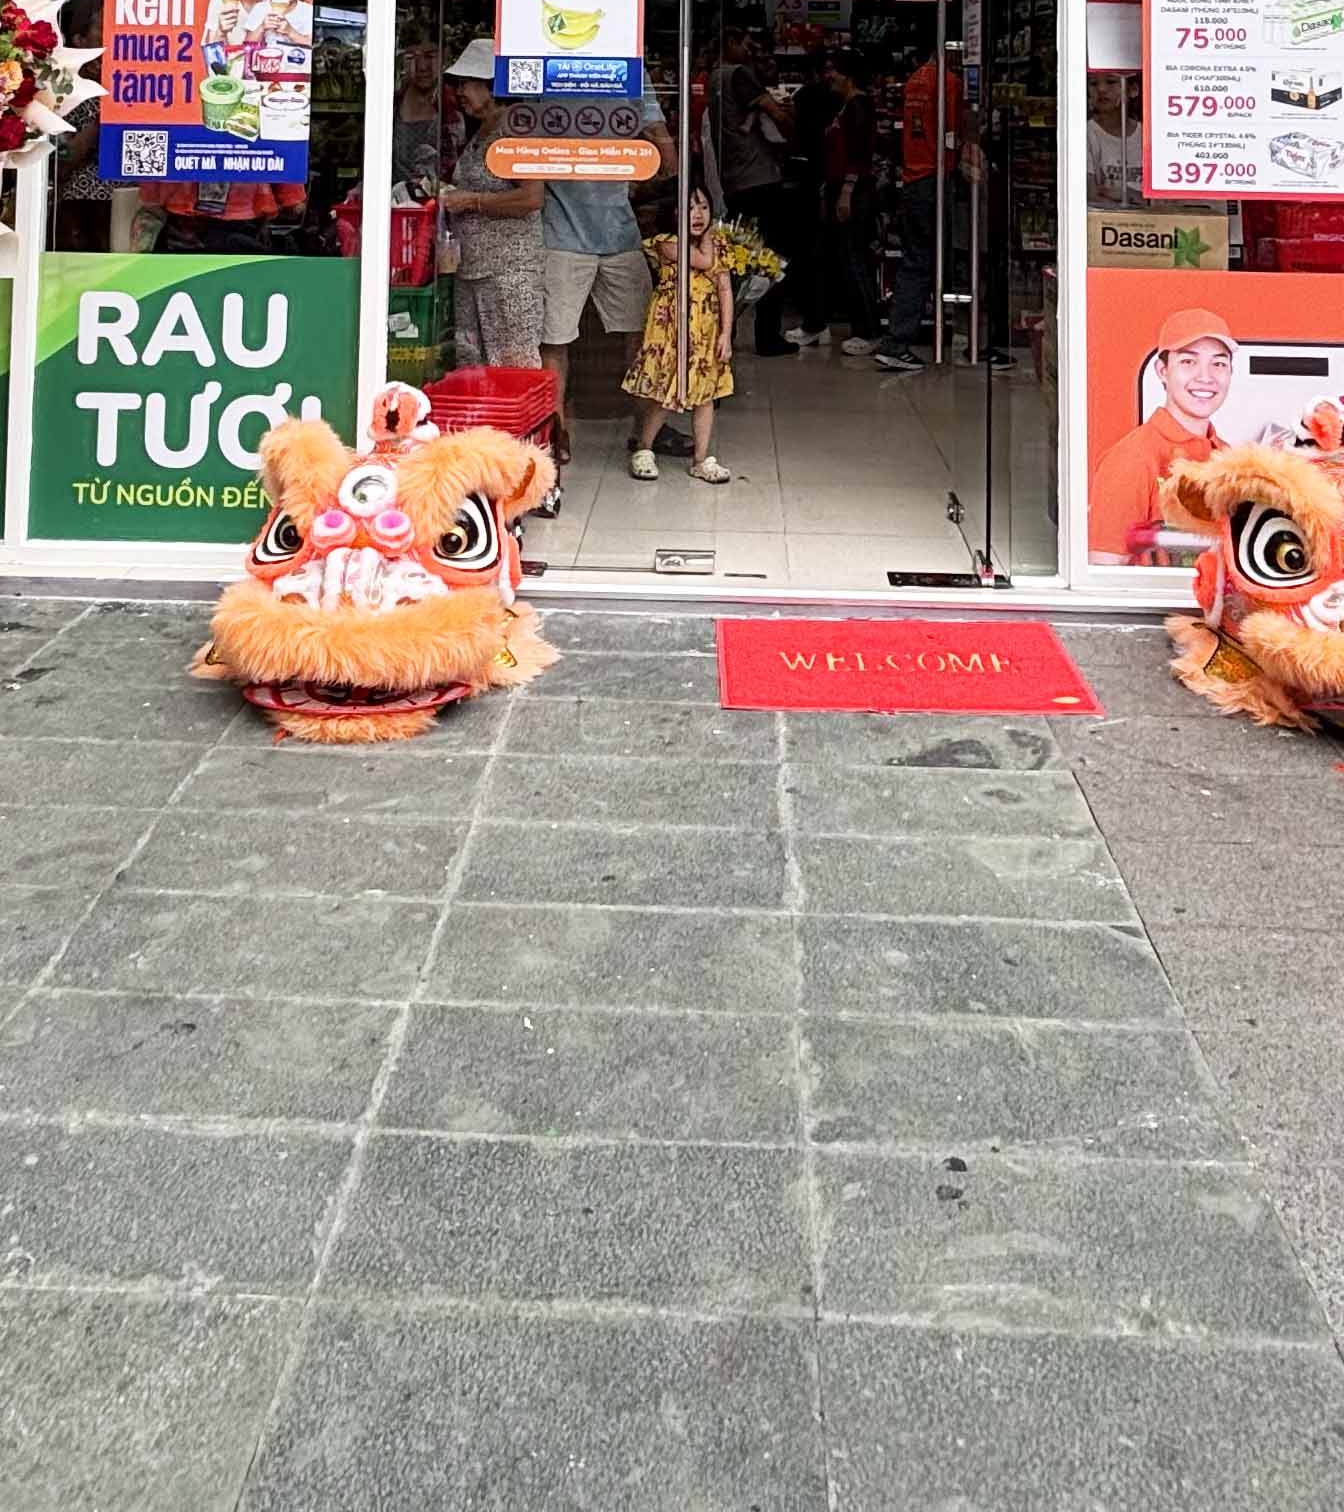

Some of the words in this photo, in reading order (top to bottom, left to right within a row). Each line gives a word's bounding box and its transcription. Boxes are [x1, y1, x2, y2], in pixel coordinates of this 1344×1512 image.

[112, 33, 170, 62] mua
[176, 31, 193, 62] 2
[1175, 27, 1247, 49] 75.000
[112, 70, 174, 108] tặng
[182, 71, 193, 103] 1
[1167, 95, 1256, 118] 579.000
[1167, 162, 1257, 185] 397.000
[1101, 226, 1178, 249] Dasani
[76, 290, 289, 369] RAU
[72, 479, 113, 506] TỪ
[116, 476, 216, 508] NGUỒN
[779, 650, 1020, 674] WELCOME
